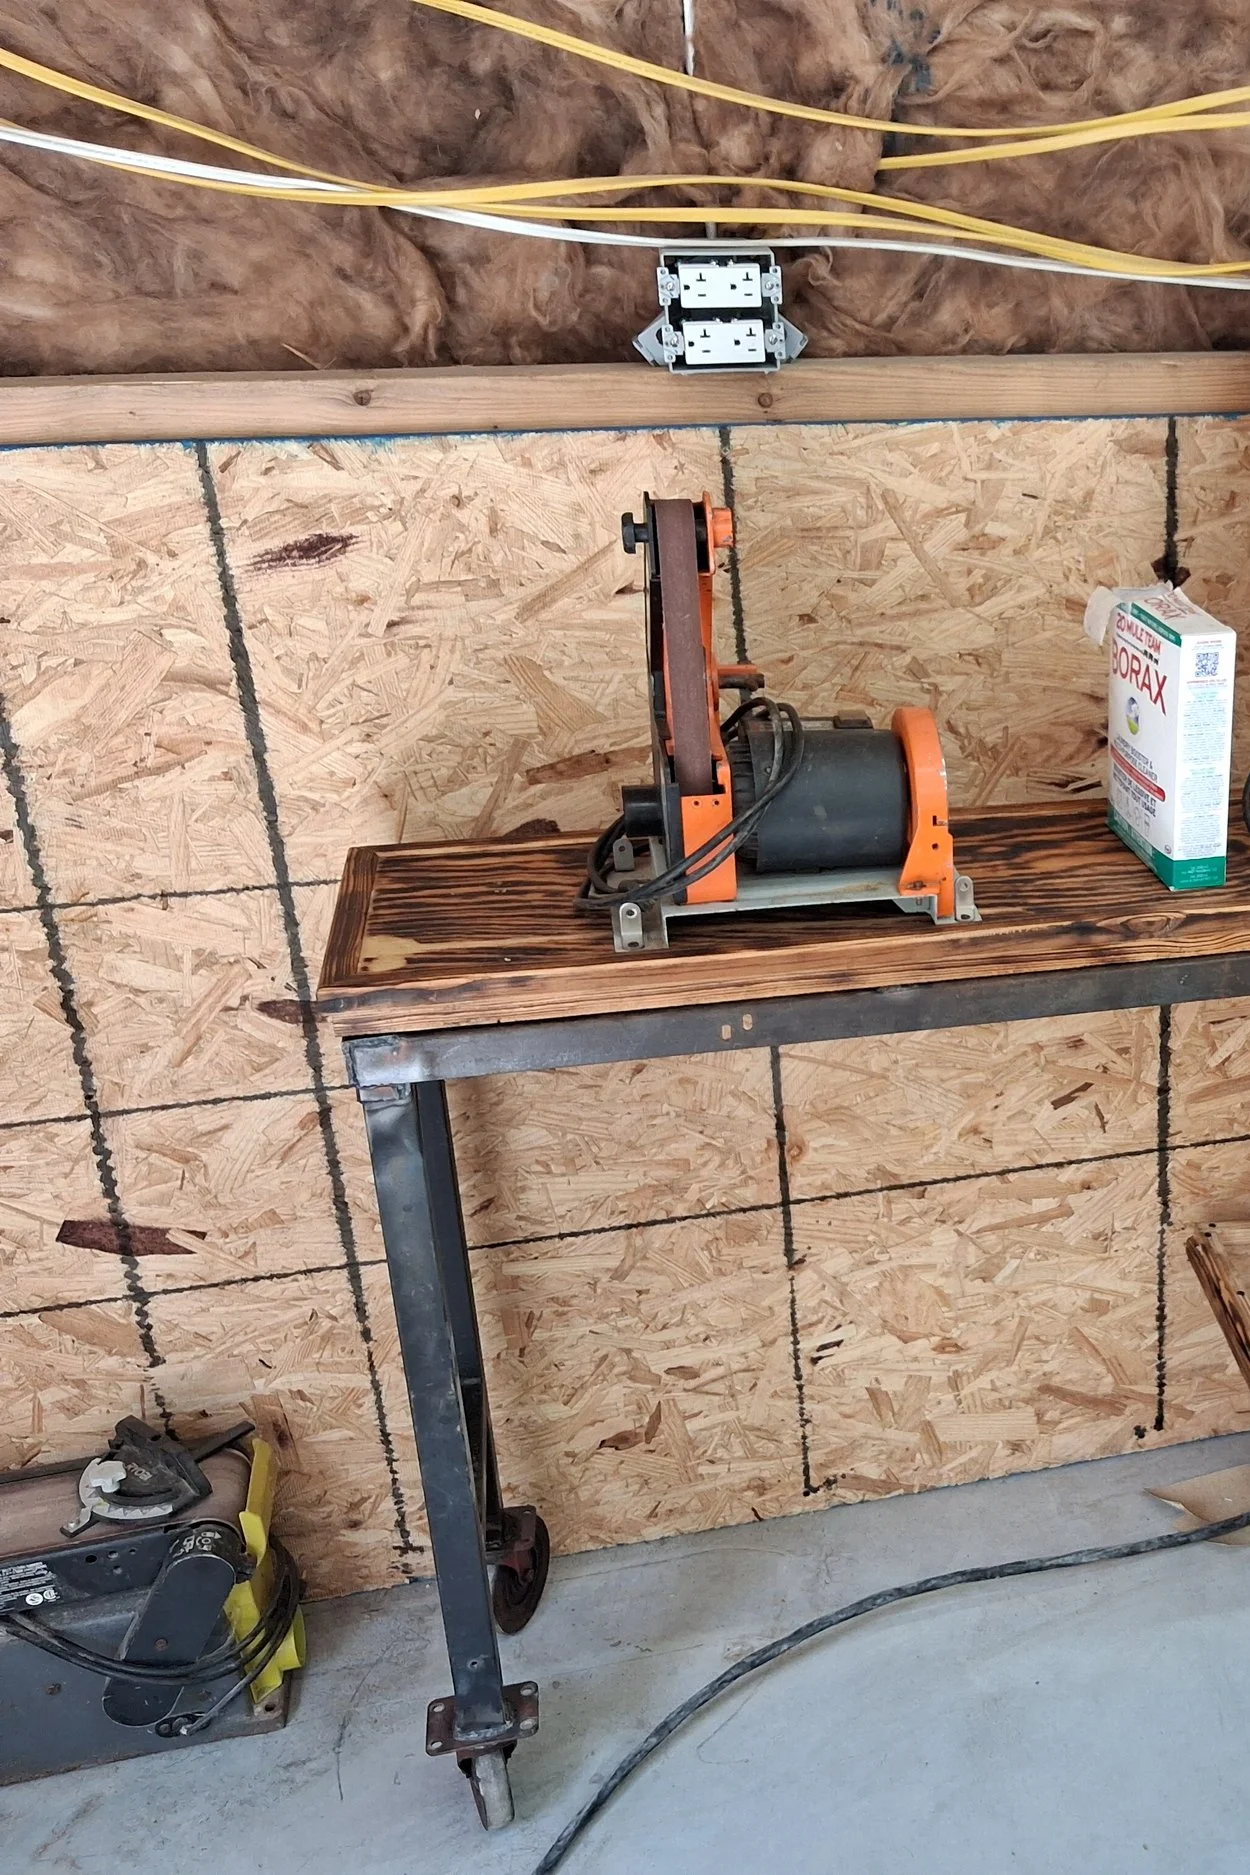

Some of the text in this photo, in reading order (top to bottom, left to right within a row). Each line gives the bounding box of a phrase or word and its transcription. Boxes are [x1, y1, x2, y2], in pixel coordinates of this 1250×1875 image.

[1143, 597, 1187, 620] ORAX
[1116, 612, 1126, 632] 20
[1126, 618, 1144, 643] MULE
[1144, 630, 1161, 655] TEAM
[1112, 637, 1168, 716] BORAX
[126, 1462, 152, 1480] RYOBI
